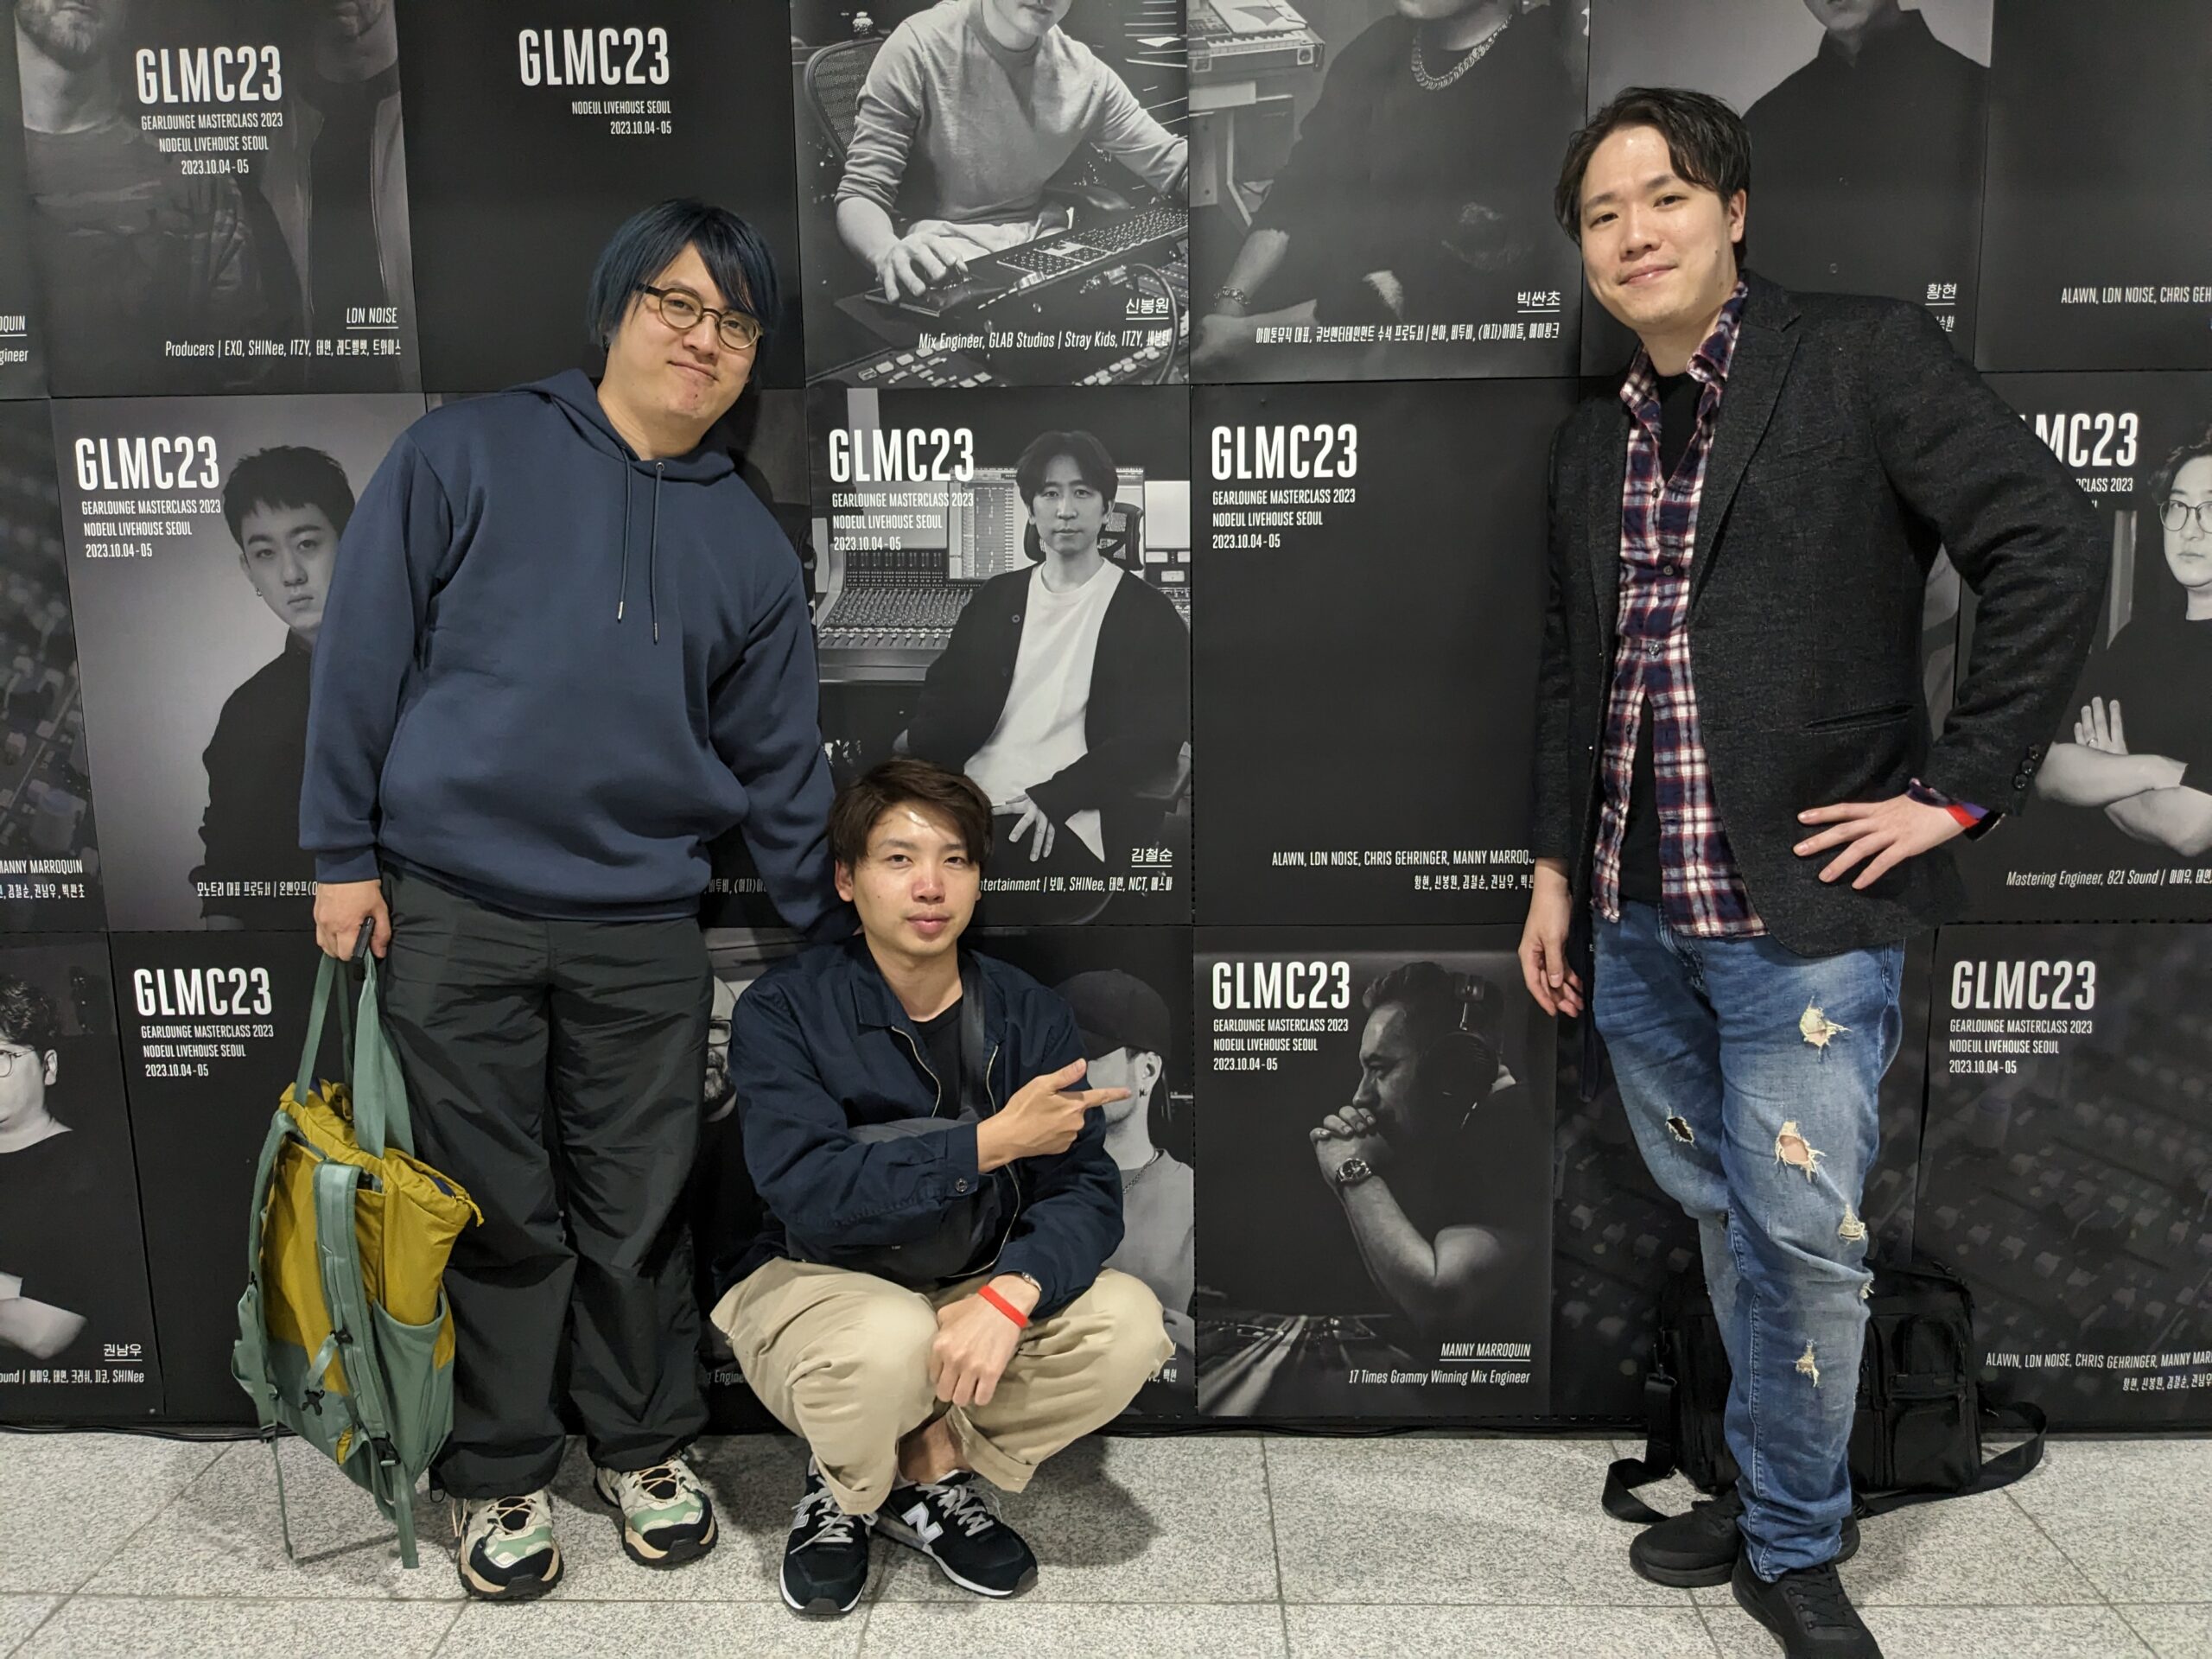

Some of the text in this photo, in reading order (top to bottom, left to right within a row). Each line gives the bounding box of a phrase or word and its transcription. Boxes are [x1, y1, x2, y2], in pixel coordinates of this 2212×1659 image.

[518, 27, 670, 86] GLMC23
[136, 45, 282, 104] GLMC23
[572, 100, 671, 115] NODEUL LIVEHOUSE SEOUL
[141, 112, 283, 130] GEARLOUNGE MASTERCLASS 2023
[159, 136, 269, 152] NODEUL LIVEHOUSE SEOUL
[1517, 290, 1560, 307] 빅싼초
[1926, 283, 1957, 300] 황현
[2061, 287, 2099, 304] ALAWN,
[2102, 287, 2121, 303] LDN
[2125, 286, 2157, 304] NOISE,
[2159, 286, 2190, 303] CHRIS
[1126, 297, 1169, 314] 신봉원
[346, 308, 397, 324] LDN NOISE
[919, 333, 936, 349] Mix
[940, 332, 985, 352] Engineer,
[988, 332, 1013, 348] GLAB
[1017, 331, 1054, 348] Studios
[1065, 331, 1091, 351] Stray
[1094, 329, 1118, 348] Kids,
[1122, 329, 1143, 348] ITZY,
[1377, 325, 1392, 341] 수석
[1394, 325, 1424, 341] 프로듀서
[1431, 324, 1449, 342] 현아,
[1451, 324, 1475, 342] 비투비,
[165, 339, 401, 358] Producers EXO, SHINee, ITZY, 태연, 레드벨벳, 트와이스
[829, 428, 974, 483] GLMC23
[1211, 423, 1357, 480] GLMC23
[74, 435, 219, 491] GLMC23
[2110, 477, 2133, 492] 2023
[831, 492, 974, 508] GEARLOUNGE MASTERCLASS 2023
[1212, 488, 1356, 505] GEARLOUNGE MASTERCLASS 2023
[81, 499, 221, 516] GEARLOUNGE MASTERCLASS 2023
[833, 514, 943, 530] NODEUL LIVEHOUSE SEOUL
[1212, 511, 1323, 527] NODEUL LIVEHOUSE SEOUL
[84, 521, 192, 537] NODEUL LIVEHOUSE SEOUL
[1131, 848, 1173, 862] 김철순
[1272, 849, 1487, 867] ALAWN, LDN NOISE, CHRIS GEHRINGER, MANNY
[29, 859, 83, 874] MARROQUIN
[1049, 876, 1173, 893] 보아, SHINee, 태연, NCT, 에스파
[1414, 874, 1432, 891] 황현,
[1434, 874, 1460, 891] 신봉원,
[1462, 874, 1489, 891] 김철순,
[2006, 871, 2056, 888] Mastering
[2059, 870, 2103, 887] Engineer,
[2107, 870, 2126, 885] 821
[2127, 869, 2159, 885] Sound
[226, 881, 240, 896] 대표
[244, 881, 270, 896] 프로듀서
[133, 967, 272, 1016] GLMC23
[1212, 961, 1350, 1010] GLMC23
[1951, 960, 2096, 1010] GLMC23
[141, 1024, 274, 1039] GEARLOUNGE MASTERCLASS 2023
[1213, 1018, 1349, 1032] GEARLOUNGE MASTERCLASS 2023
[1949, 1019, 2093, 1034] GEARLOUNGE MASTERCLASS 2023
[143, 1044, 246, 1058] NODEUL LIVEHOUSE SEOUL
[1213, 1039, 1318, 1052] NODEUL LIVEHOUSE SEOUL
[1949, 1039, 2059, 1054] NODEUL LIVEHOUSE SEOUL
[104, 1344, 142, 1357] 권남우
[1440, 1343, 1531, 1357] MANNY MARROQUIN
[1986, 1351, 2191, 1370] ALAWN, LDN NOISE, CHRIS GEHRINGER, MANNY
[112, 1369, 144, 1383] SHINee
[1349, 1370, 1530, 1386] 17 Times Grammy Winning Mix Engineer
